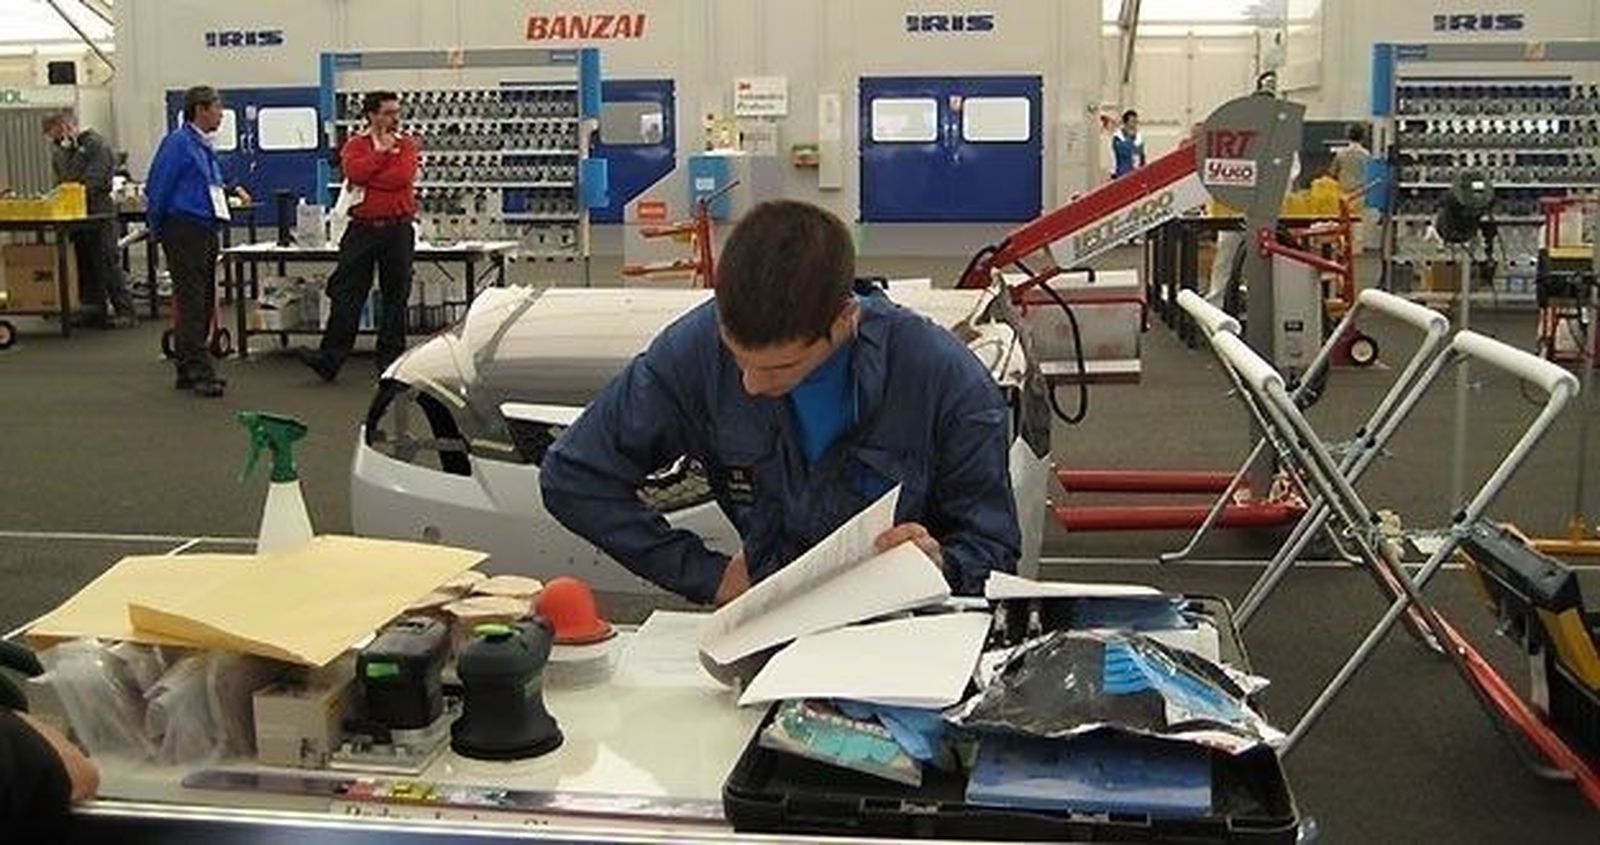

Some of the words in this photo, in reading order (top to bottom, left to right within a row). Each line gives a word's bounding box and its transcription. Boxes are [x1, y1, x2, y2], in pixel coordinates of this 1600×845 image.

[526, 14, 646, 40] BANZAI
[905, 14, 994, 31] IRIS
[1433, 14, 1524, 31] IRIS
[205, 30, 284, 47] IRIS
[1207, 130, 1258, 158] IRT
